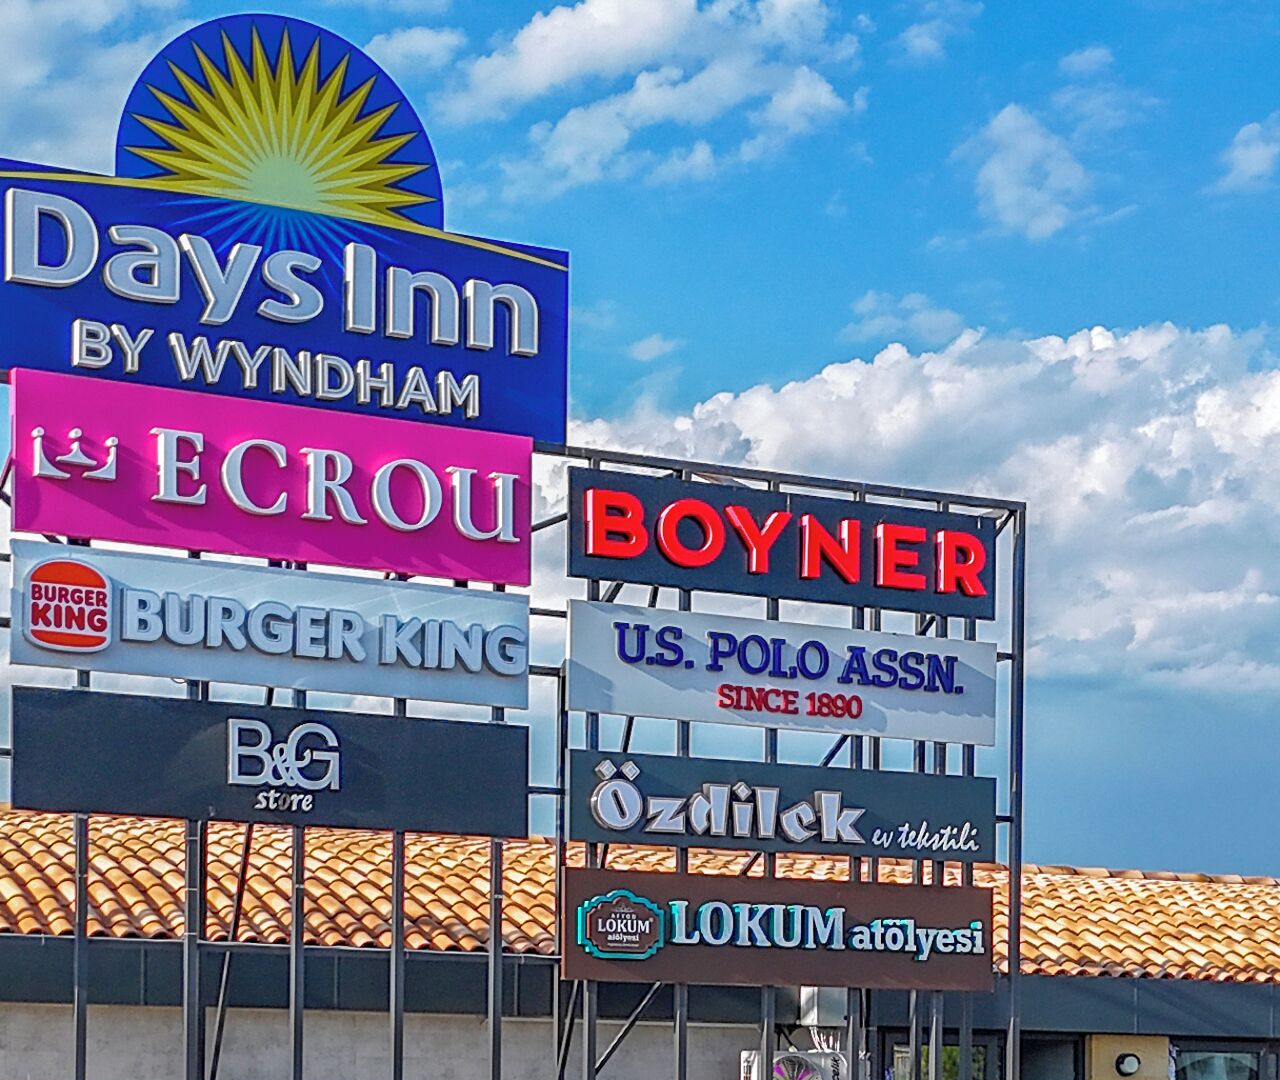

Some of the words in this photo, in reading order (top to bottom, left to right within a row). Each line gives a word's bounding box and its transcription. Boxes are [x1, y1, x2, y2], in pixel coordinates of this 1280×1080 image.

[5, 187, 324, 326] Days
[344, 241, 539, 357] Inn
[71, 318, 154, 374] BY
[168, 332, 480, 420] WYNDHAM
[150, 426, 524, 543] ECROU
[585, 487, 988, 597] BOYNER
[31, 584, 107, 608] BURGER
[31, 601, 107, 633] KING
[121, 587, 367, 662] BURGER
[380, 618, 528, 676] KING
[614, 622, 695, 669] U.S.
[705, 631, 830, 680] POLO
[838, 646, 964, 694] ASSN.
[717, 684, 799, 715] SINCE
[807, 693, 862, 719] 1890
[226, 718, 340, 790] B&G
[254, 789, 313, 811] store
[591, 760, 866, 843] Özdilek
[872, 828, 893, 848] ev
[597, 918, 650, 933] LOKUM
[668, 900, 846, 951] LOKUM
[851, 918, 985, 961] atölyesi
